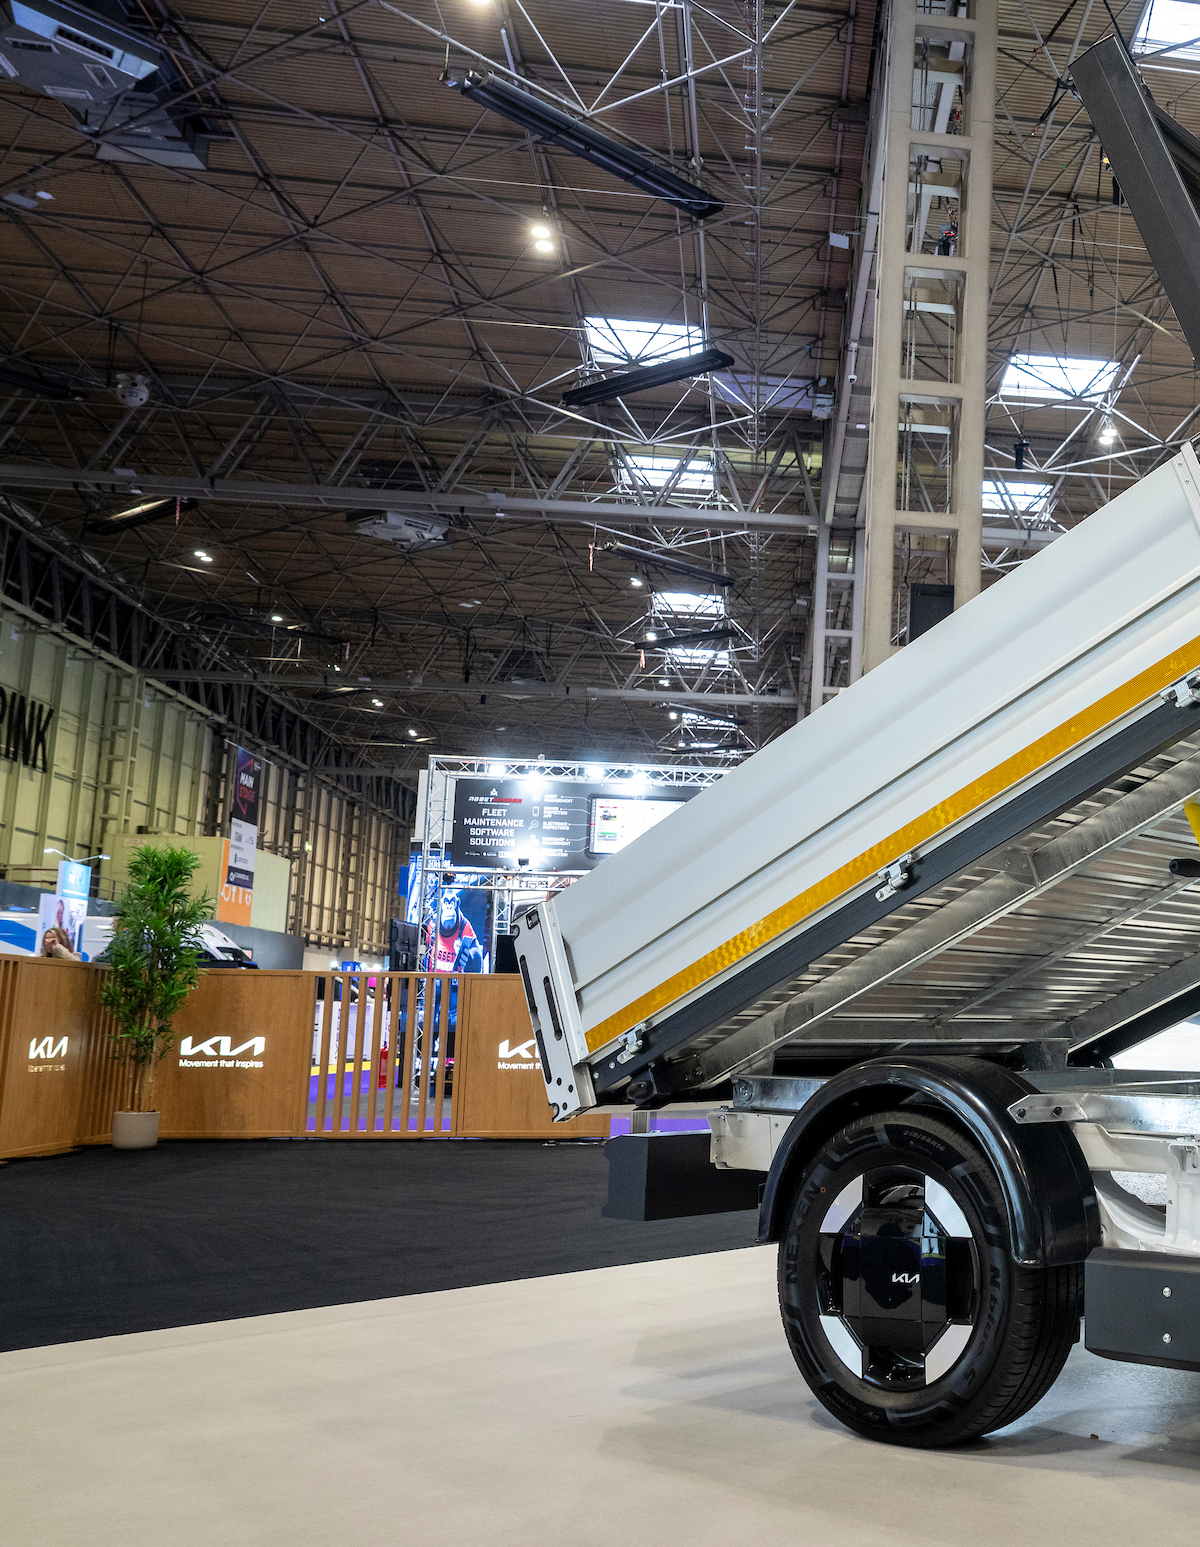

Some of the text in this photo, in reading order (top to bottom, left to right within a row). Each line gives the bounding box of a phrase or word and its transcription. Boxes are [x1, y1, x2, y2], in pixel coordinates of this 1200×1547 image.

[240, 771, 255, 789] MAIN
[239, 785, 256, 803] STAGE
[482, 807, 508, 817] FLEET
[463, 817, 525, 828] MAINTENANCE
[469, 827, 516, 838] SOFTWARE
[469, 837, 516, 847] SOLUTIONS
[437, 950, 454, 963] SSET
[29, 1036, 69, 1060] KIA
[180, 1035, 266, 1057] KIA
[179, 1059, 264, 1069] Movement that inspires
[497, 1061, 534, 1070] Movement
[785, 1180, 821, 1285] NEXEN
[891, 1272, 920, 1284] KIA
